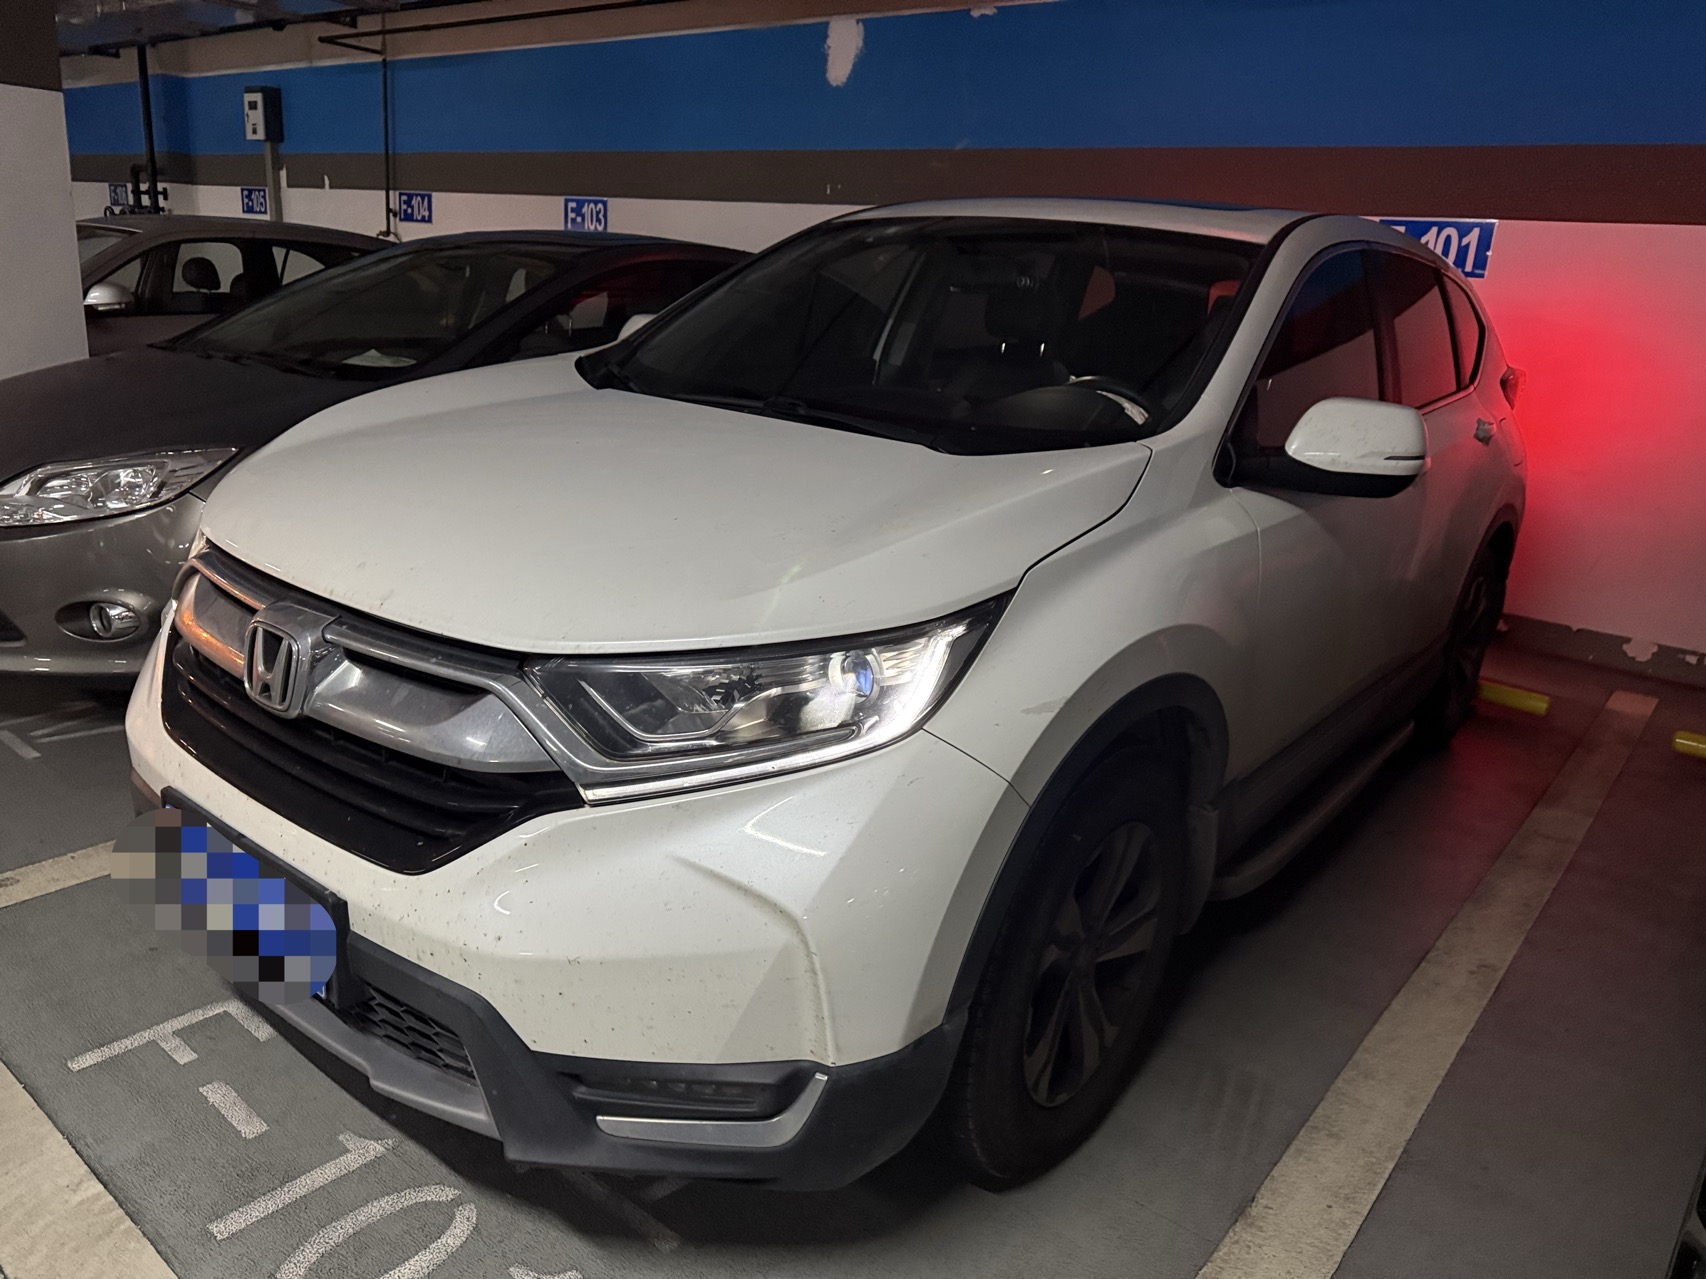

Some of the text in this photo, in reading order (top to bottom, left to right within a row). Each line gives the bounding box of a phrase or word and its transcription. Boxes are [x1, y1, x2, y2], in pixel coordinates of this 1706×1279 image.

[242, 190, 266, 212] F-105
[400, 195, 430, 221] F-104
[567, 201, 605, 232] F-103
[1391, 225, 1481, 273] 101
[67, 999, 585, 1279] F-10
